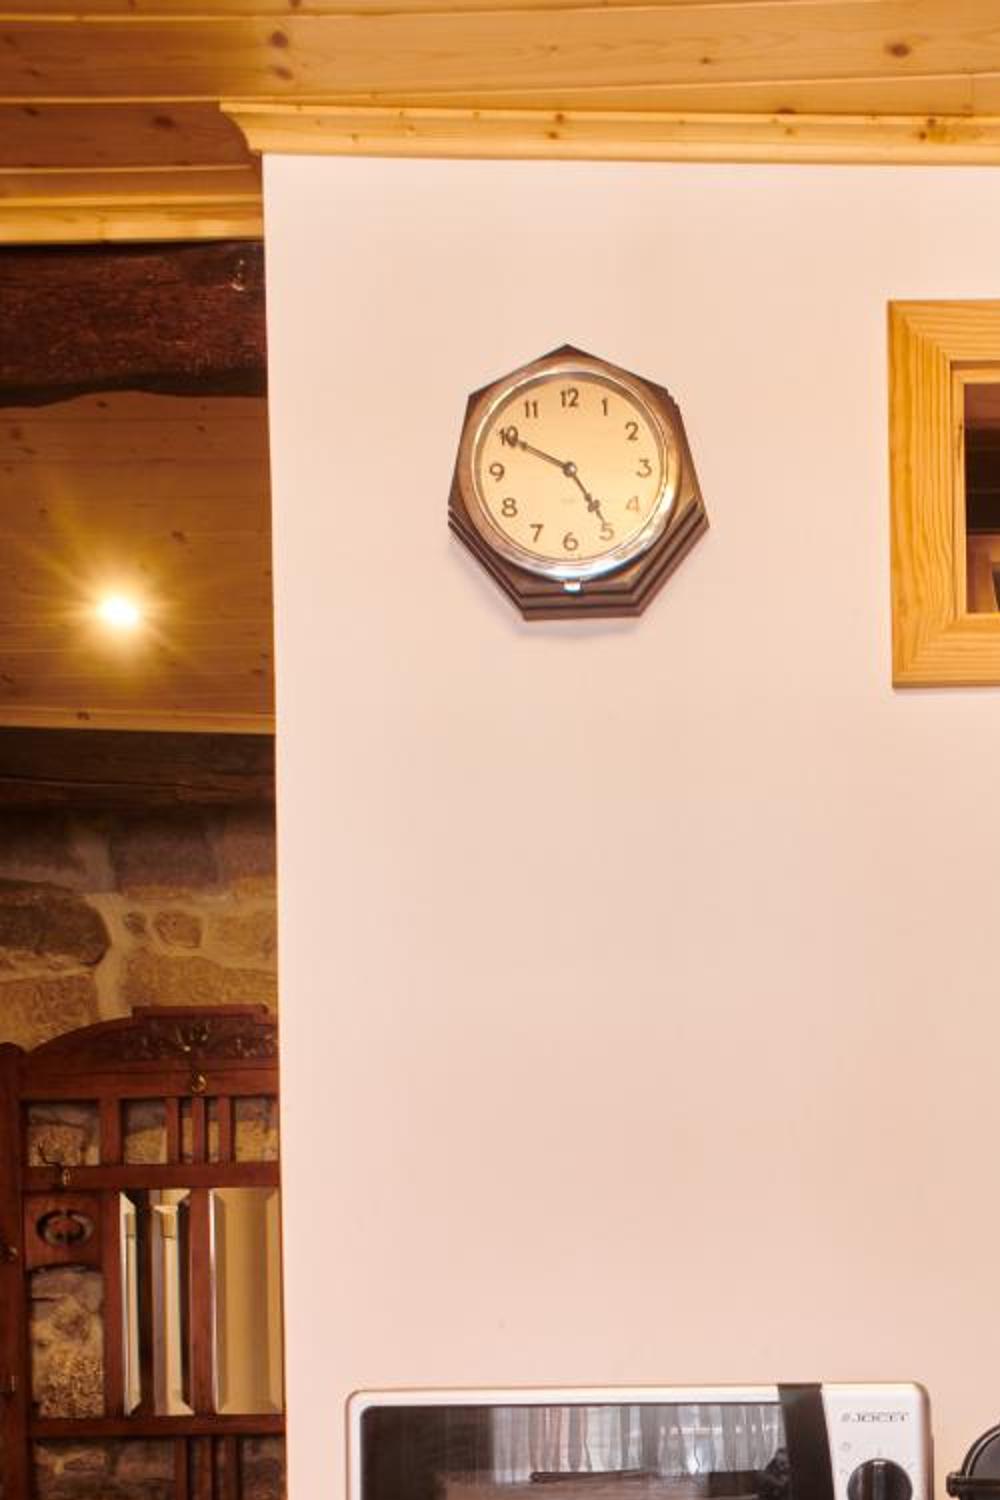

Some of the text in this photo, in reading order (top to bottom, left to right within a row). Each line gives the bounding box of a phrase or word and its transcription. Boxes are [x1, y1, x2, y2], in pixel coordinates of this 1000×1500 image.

[560, 388, 579, 408] 12
[601, 398, 608, 416] 1
[524, 401, 538, 418] 11
[499, 425, 518, 447] 10
[625, 421, 639, 441] 2
[489, 462, 505, 482] 9
[636, 459, 652, 478] 3
[501, 497, 518, 518] 8
[625, 495, 641, 513] 4
[530, 524, 544, 543] 7
[599, 520, 615, 541] 5
[563, 531, 579, 551] 6
